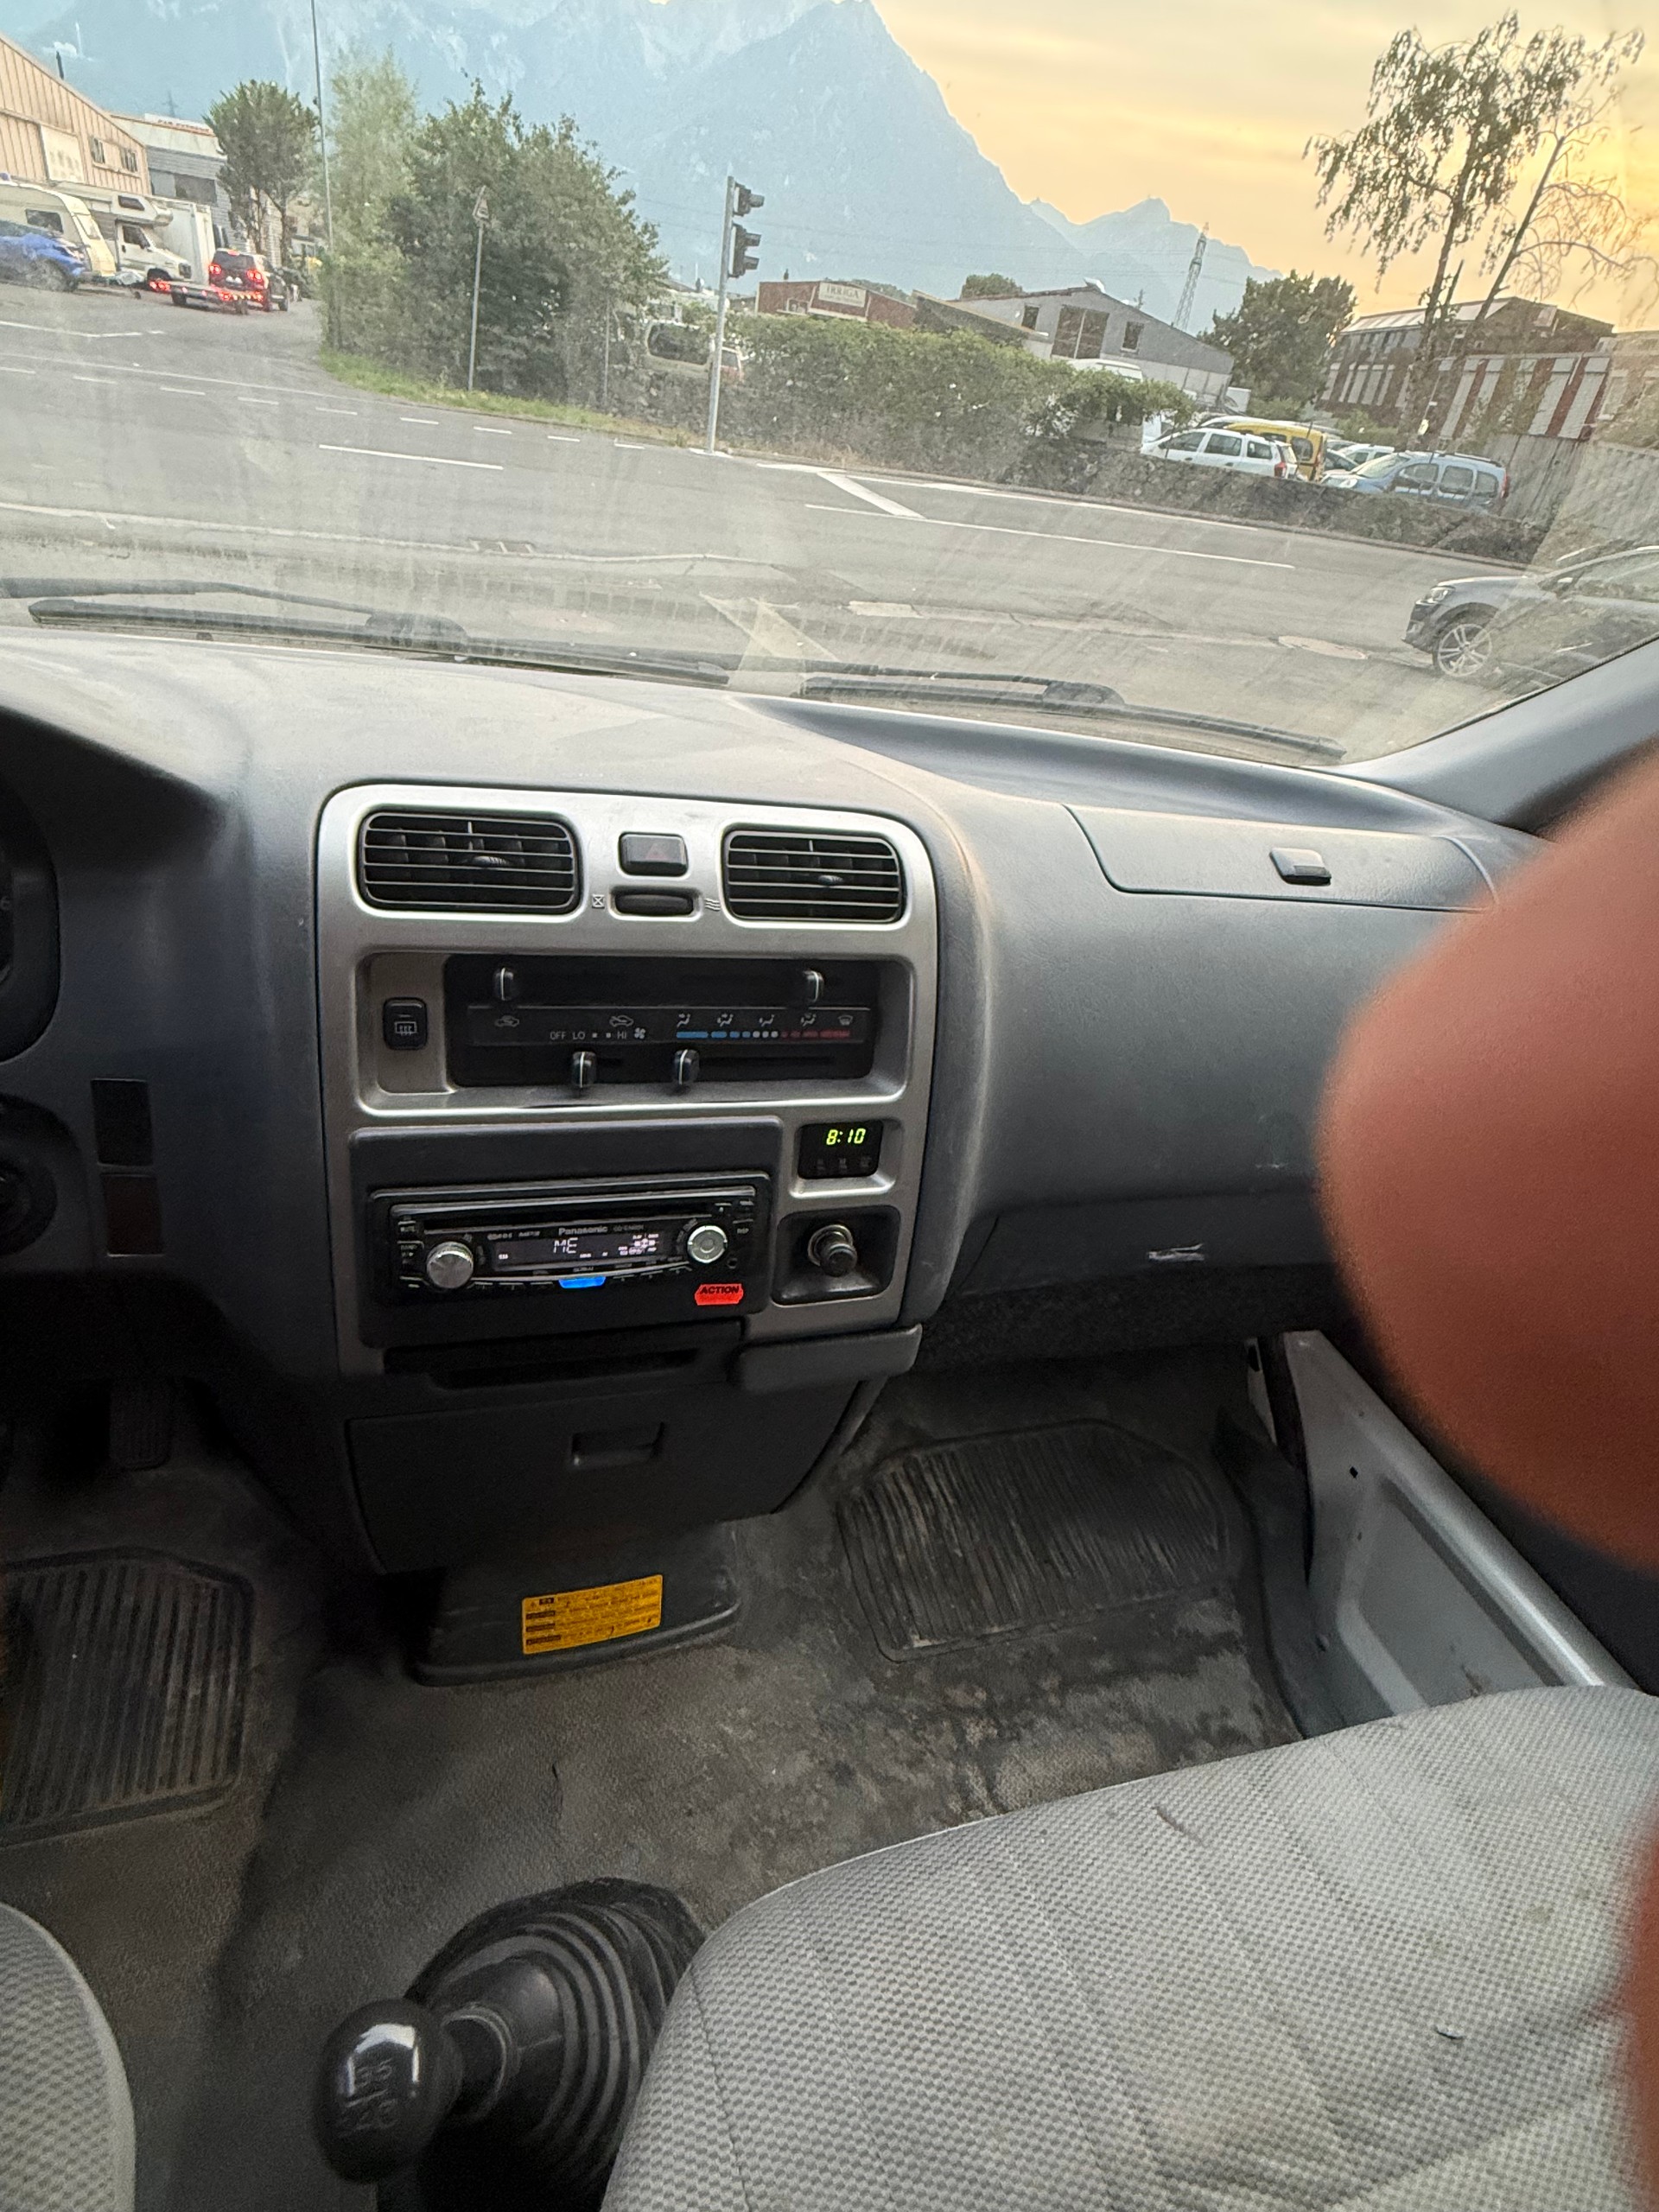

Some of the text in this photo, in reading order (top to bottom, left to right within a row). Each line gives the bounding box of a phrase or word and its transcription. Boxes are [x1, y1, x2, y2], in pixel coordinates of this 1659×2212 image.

[550, 1031, 627, 1040] OFF LO HI
[826, 1128, 867, 1145] 8:10
[558, 1226, 608, 1236] Panasonic
[700, 1286, 740, 1294] ACTION
